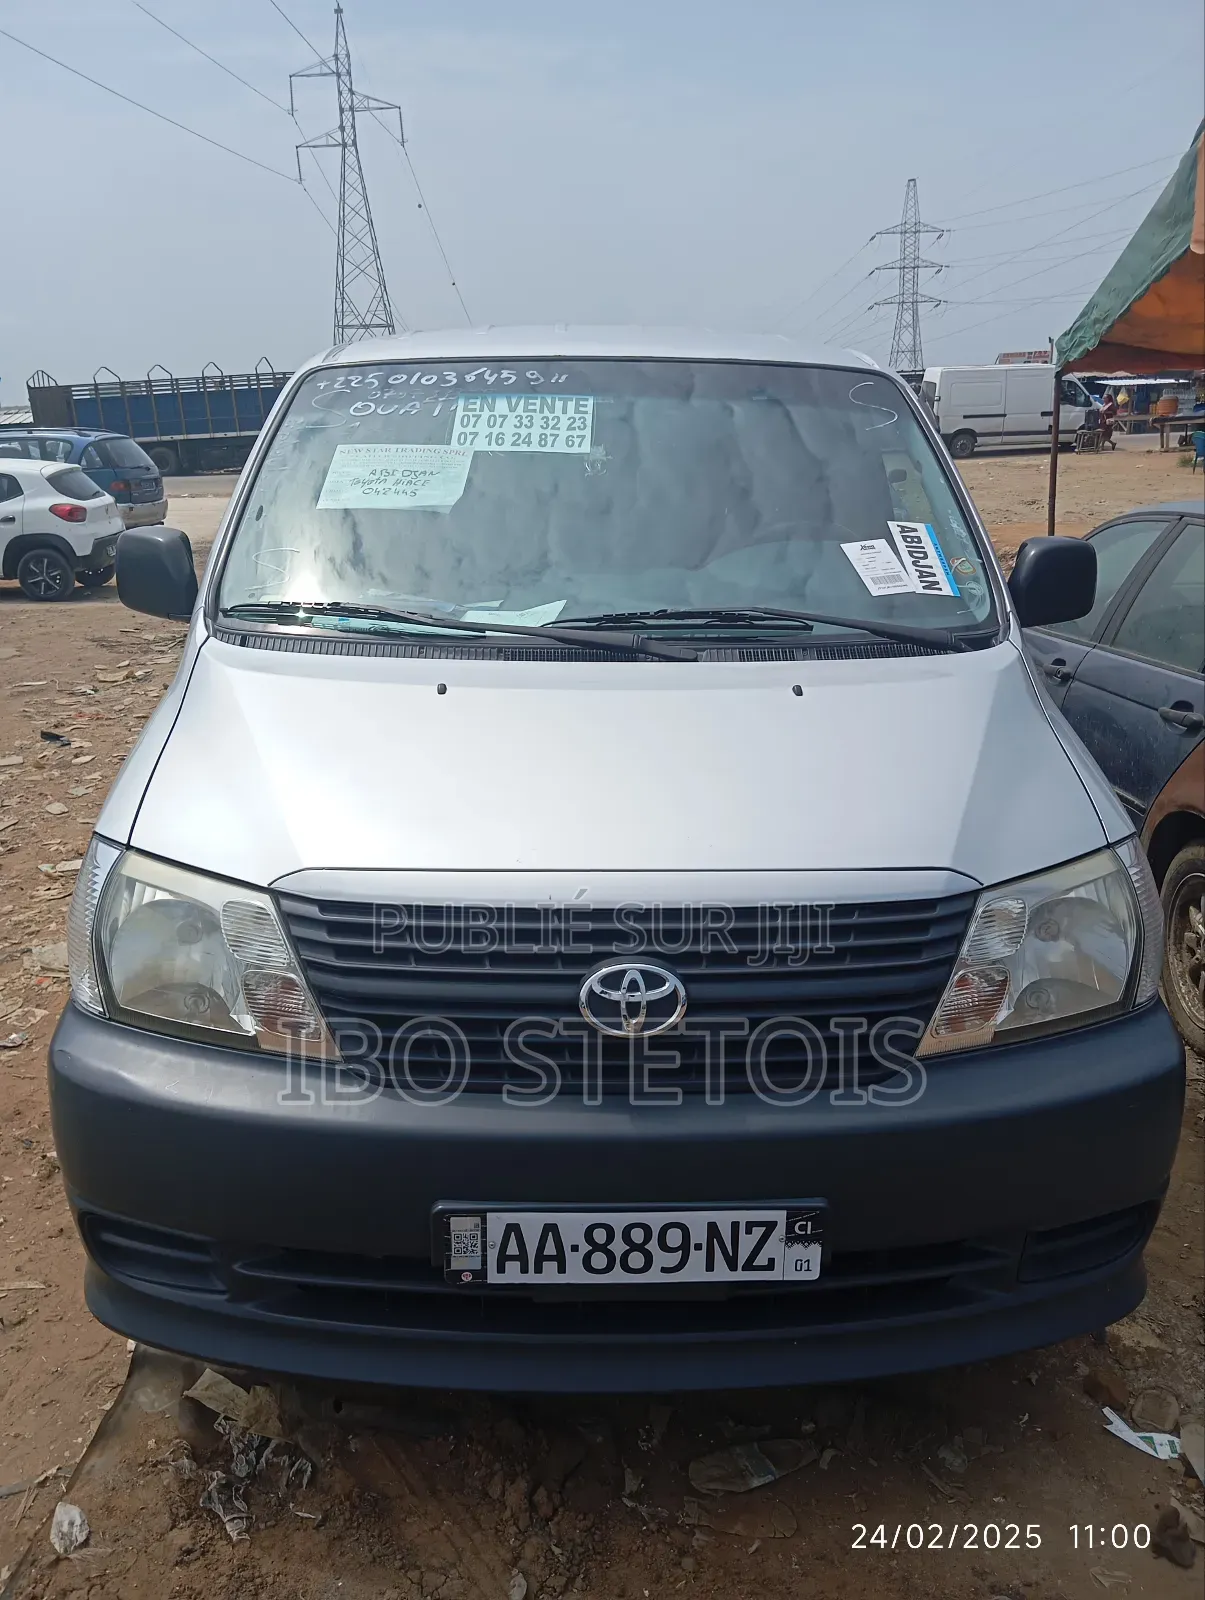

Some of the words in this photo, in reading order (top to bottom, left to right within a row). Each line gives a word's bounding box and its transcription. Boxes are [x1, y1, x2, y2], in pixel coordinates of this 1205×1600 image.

[461, 395, 497, 413] EN
[505, 396, 590, 415] VENTE
[459, 414, 482, 429] 07
[486, 414, 509, 429] 07
[513, 414, 534, 430] 33
[540, 415, 561, 431] 32
[566, 416, 588, 431] 23
[456, 431, 479, 447] 07
[484, 432, 506, 447] 16
[510, 432, 533, 448] 24
[537, 433, 560, 448] 87
[565, 434, 587, 448] 67
[395, 447, 442, 455] TRADING
[896, 524, 943, 592] ABIDJAN
[794, 1221, 812, 1235] CI
[794, 1258, 812, 1272] 01
